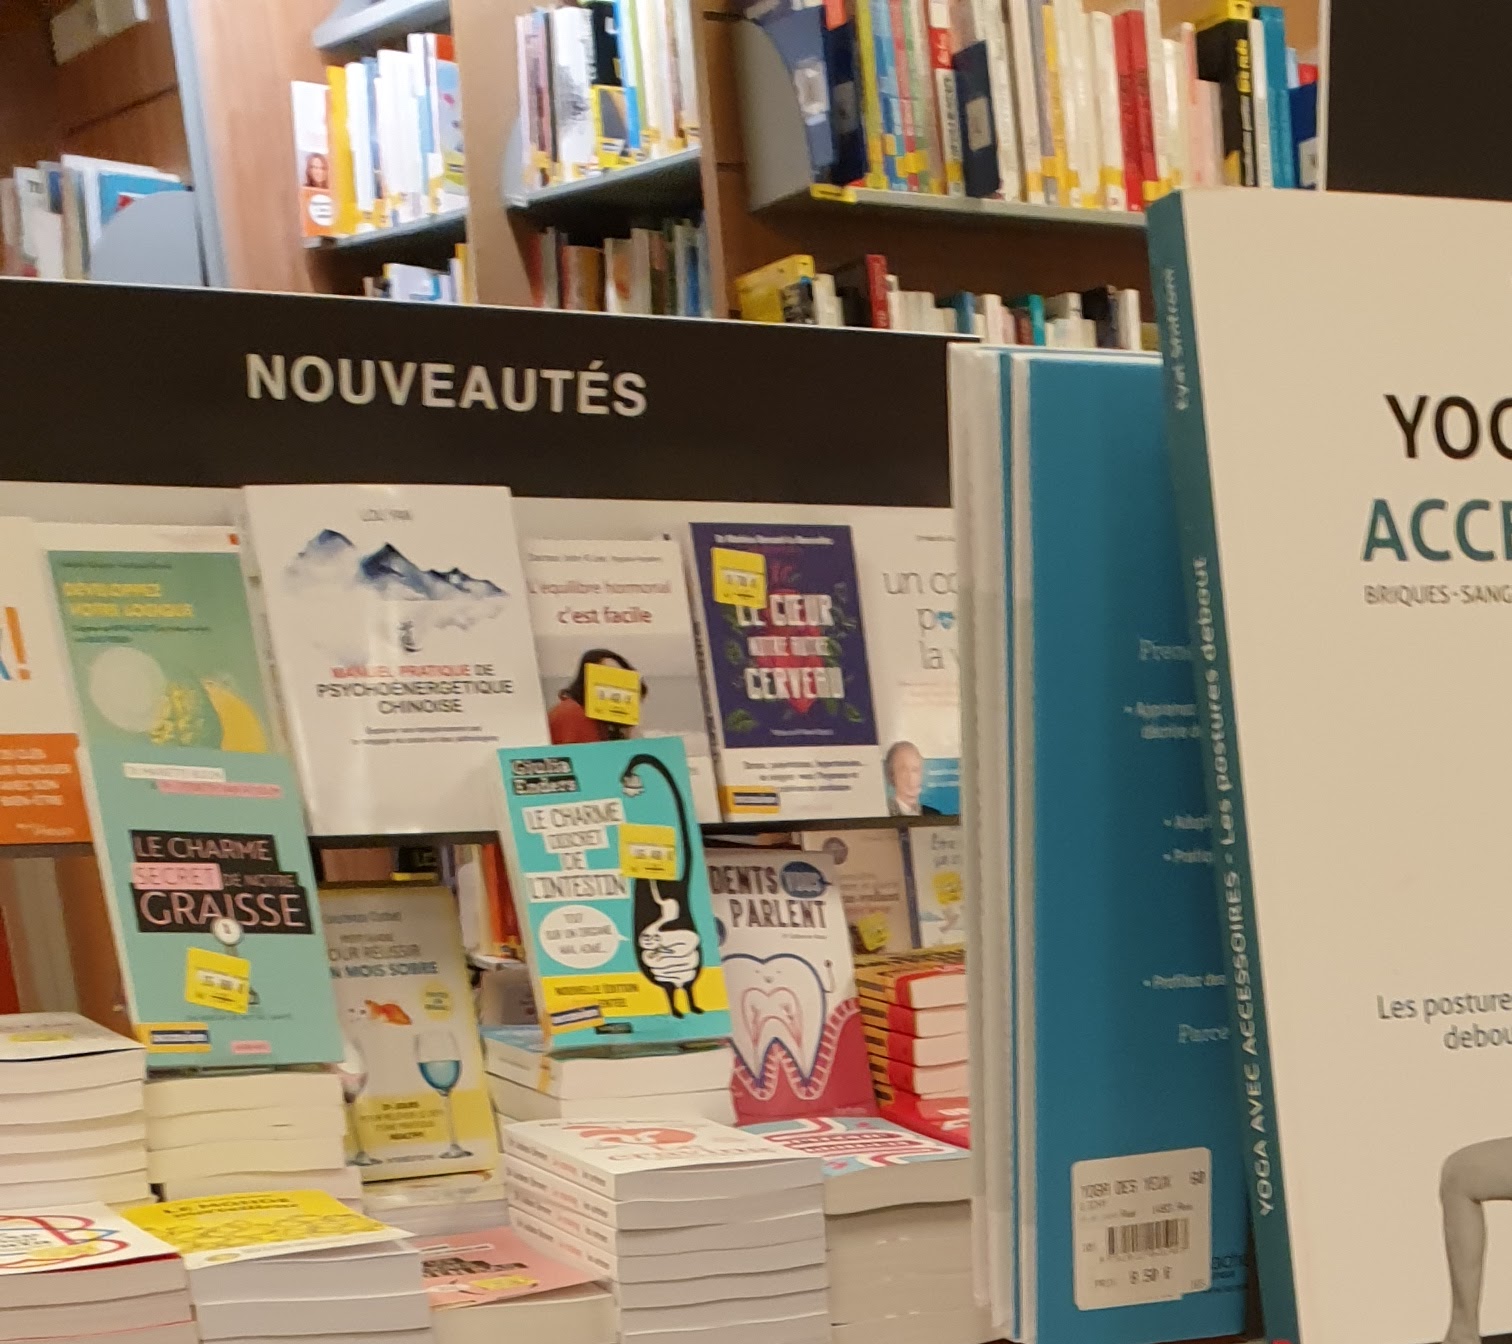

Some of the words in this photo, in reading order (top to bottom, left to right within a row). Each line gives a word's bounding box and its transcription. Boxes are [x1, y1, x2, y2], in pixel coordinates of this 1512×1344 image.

[246, 354, 648, 417] NOUVEAUTÉS
[559, 607, 598, 624] c'est
[603, 607, 652, 624] facile
[379, 700, 463, 714] CHINOISE
[553, 802, 621, 828] CHARME
[136, 836, 165, 858] LE
[173, 839, 270, 861] CHARME
[136, 865, 219, 887] SECRET
[709, 865, 779, 895] DENTS
[141, 893, 306, 927] GRAISSE
[732, 900, 827, 929] PARLENT
[1377, 994, 1416, 1021] Les
